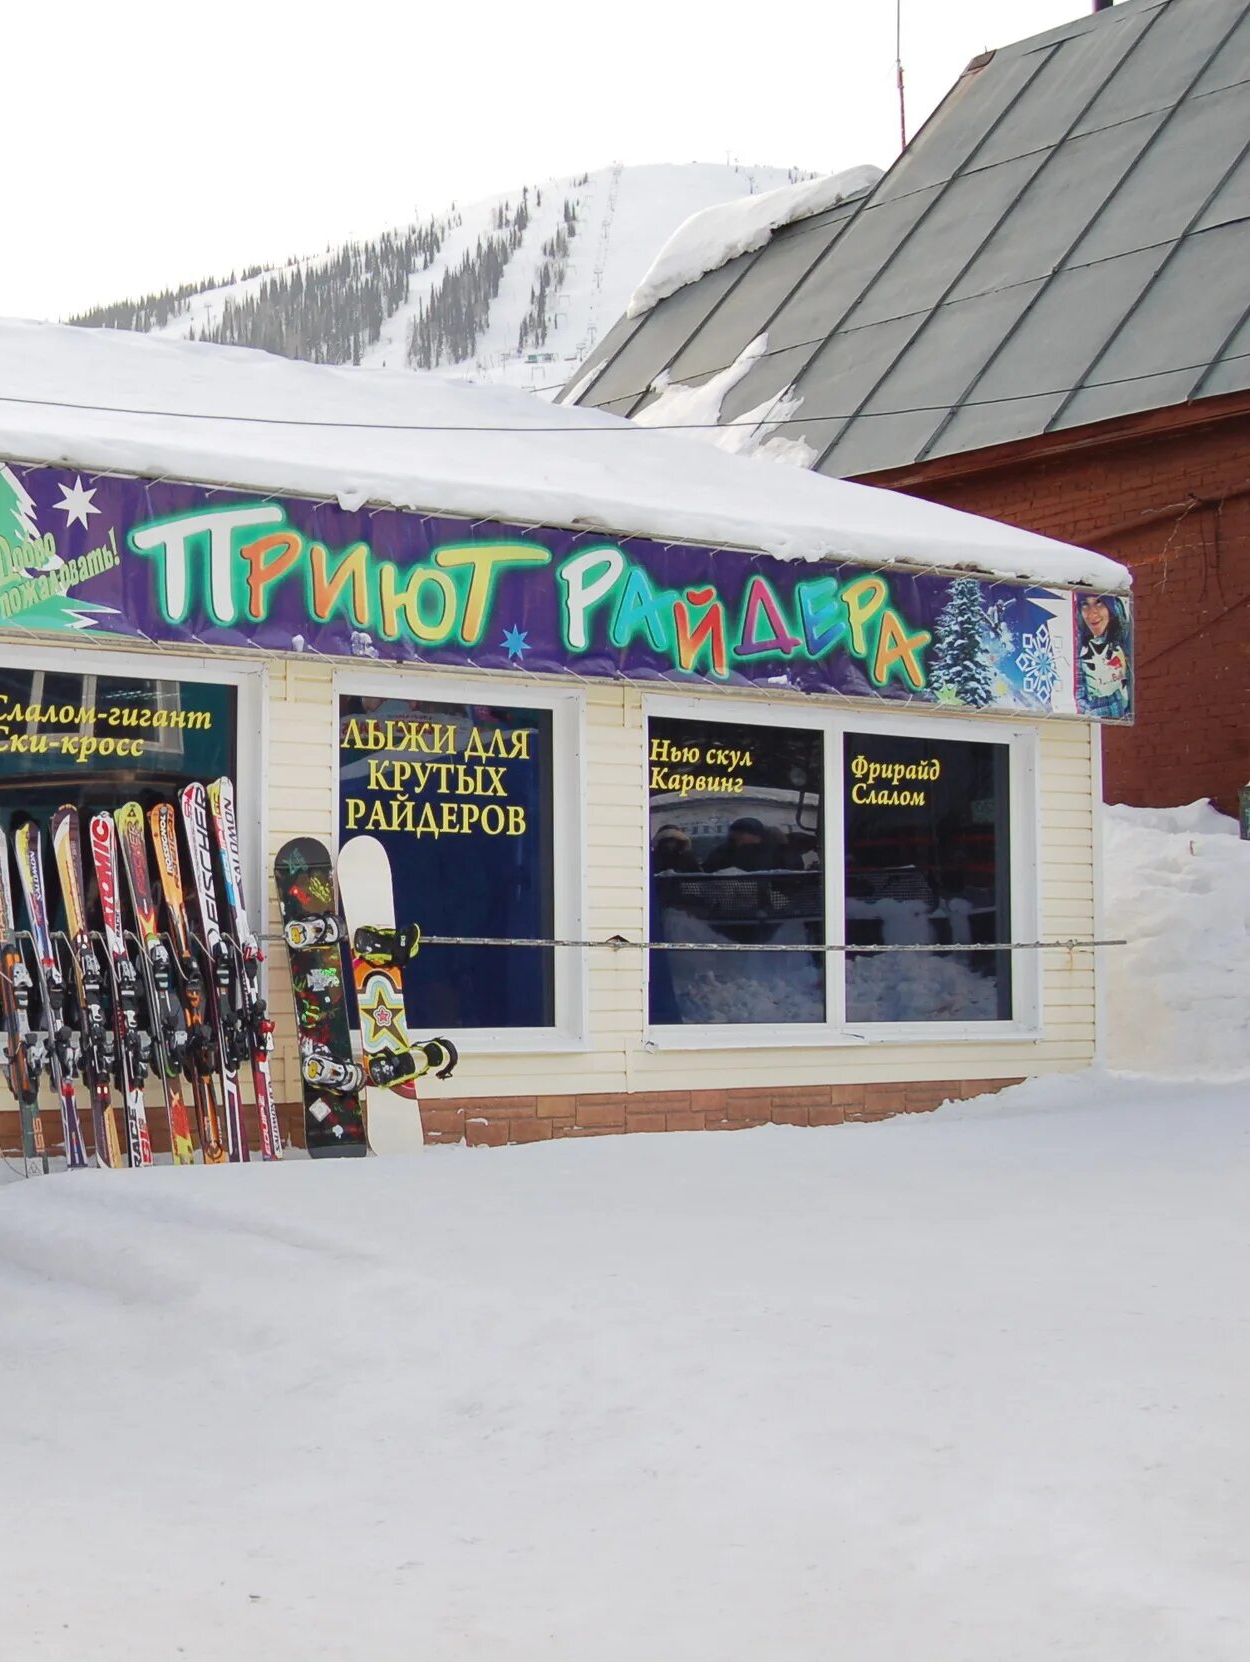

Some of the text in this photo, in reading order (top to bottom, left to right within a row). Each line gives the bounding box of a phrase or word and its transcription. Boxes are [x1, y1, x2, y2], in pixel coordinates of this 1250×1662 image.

[0, 526, 120, 620] пожаловать!
[341, 718, 530, 763] ЛЫЖИ ДЛЯ
[649, 738, 752, 773] Нью скул
[367, 759, 508, 797] КРУТЫХ
[649, 766, 743, 796] Карвинг
[851, 755, 941, 786] Фрирайд
[851, 783, 926, 806] Слалом
[345, 793, 526, 840] РАЙДЕРОВ
[91, 819, 114, 931] ATOMIC
